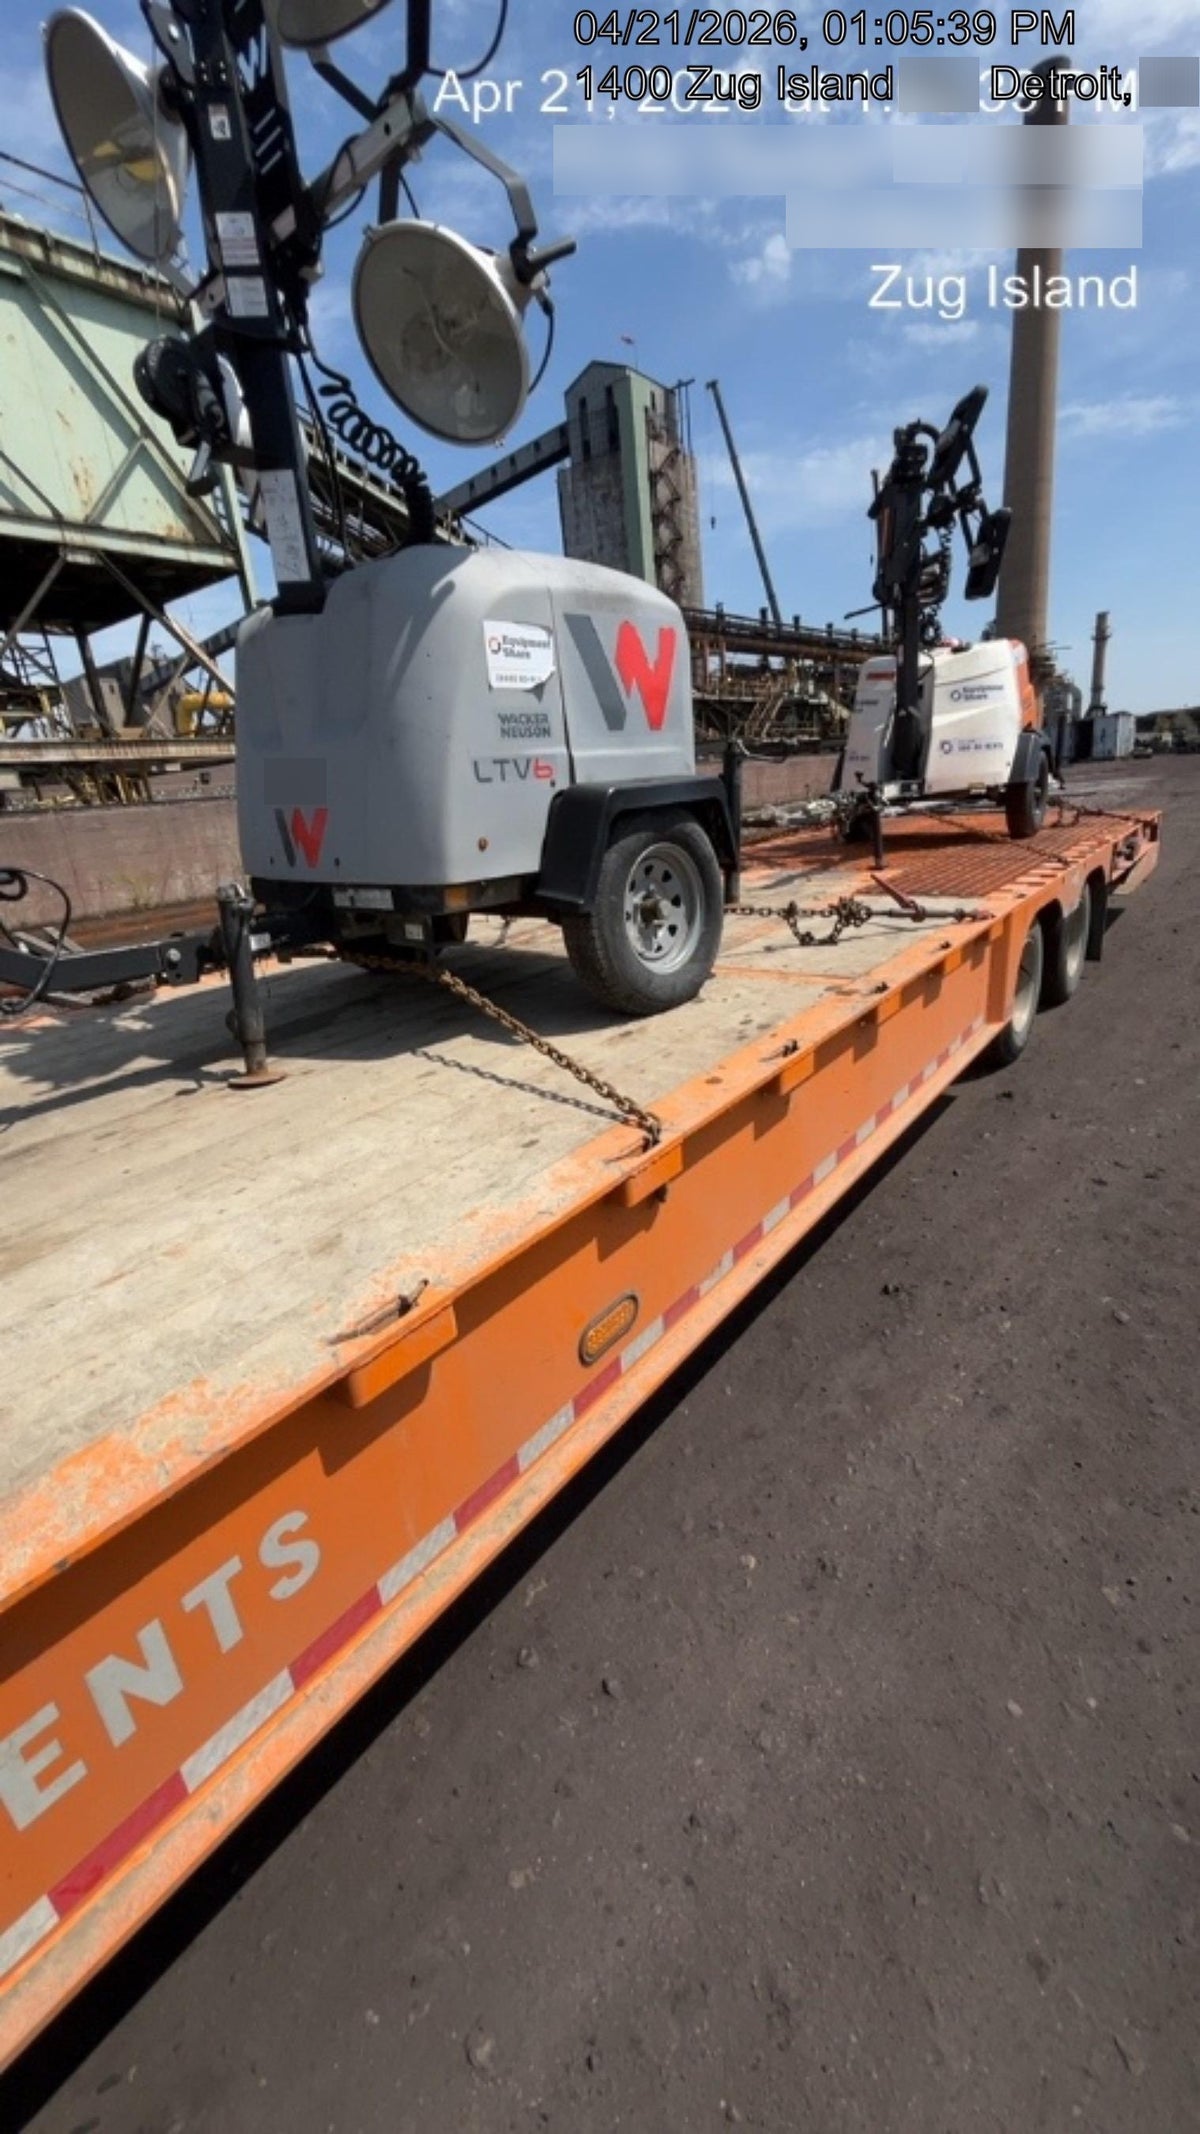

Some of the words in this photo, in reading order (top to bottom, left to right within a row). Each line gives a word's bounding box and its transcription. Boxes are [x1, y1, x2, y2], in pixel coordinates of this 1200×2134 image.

[497, 712, 549, 725] WACKER
[500, 726, 551, 738] NEUSON
[473, 757, 554, 783] LTV6
